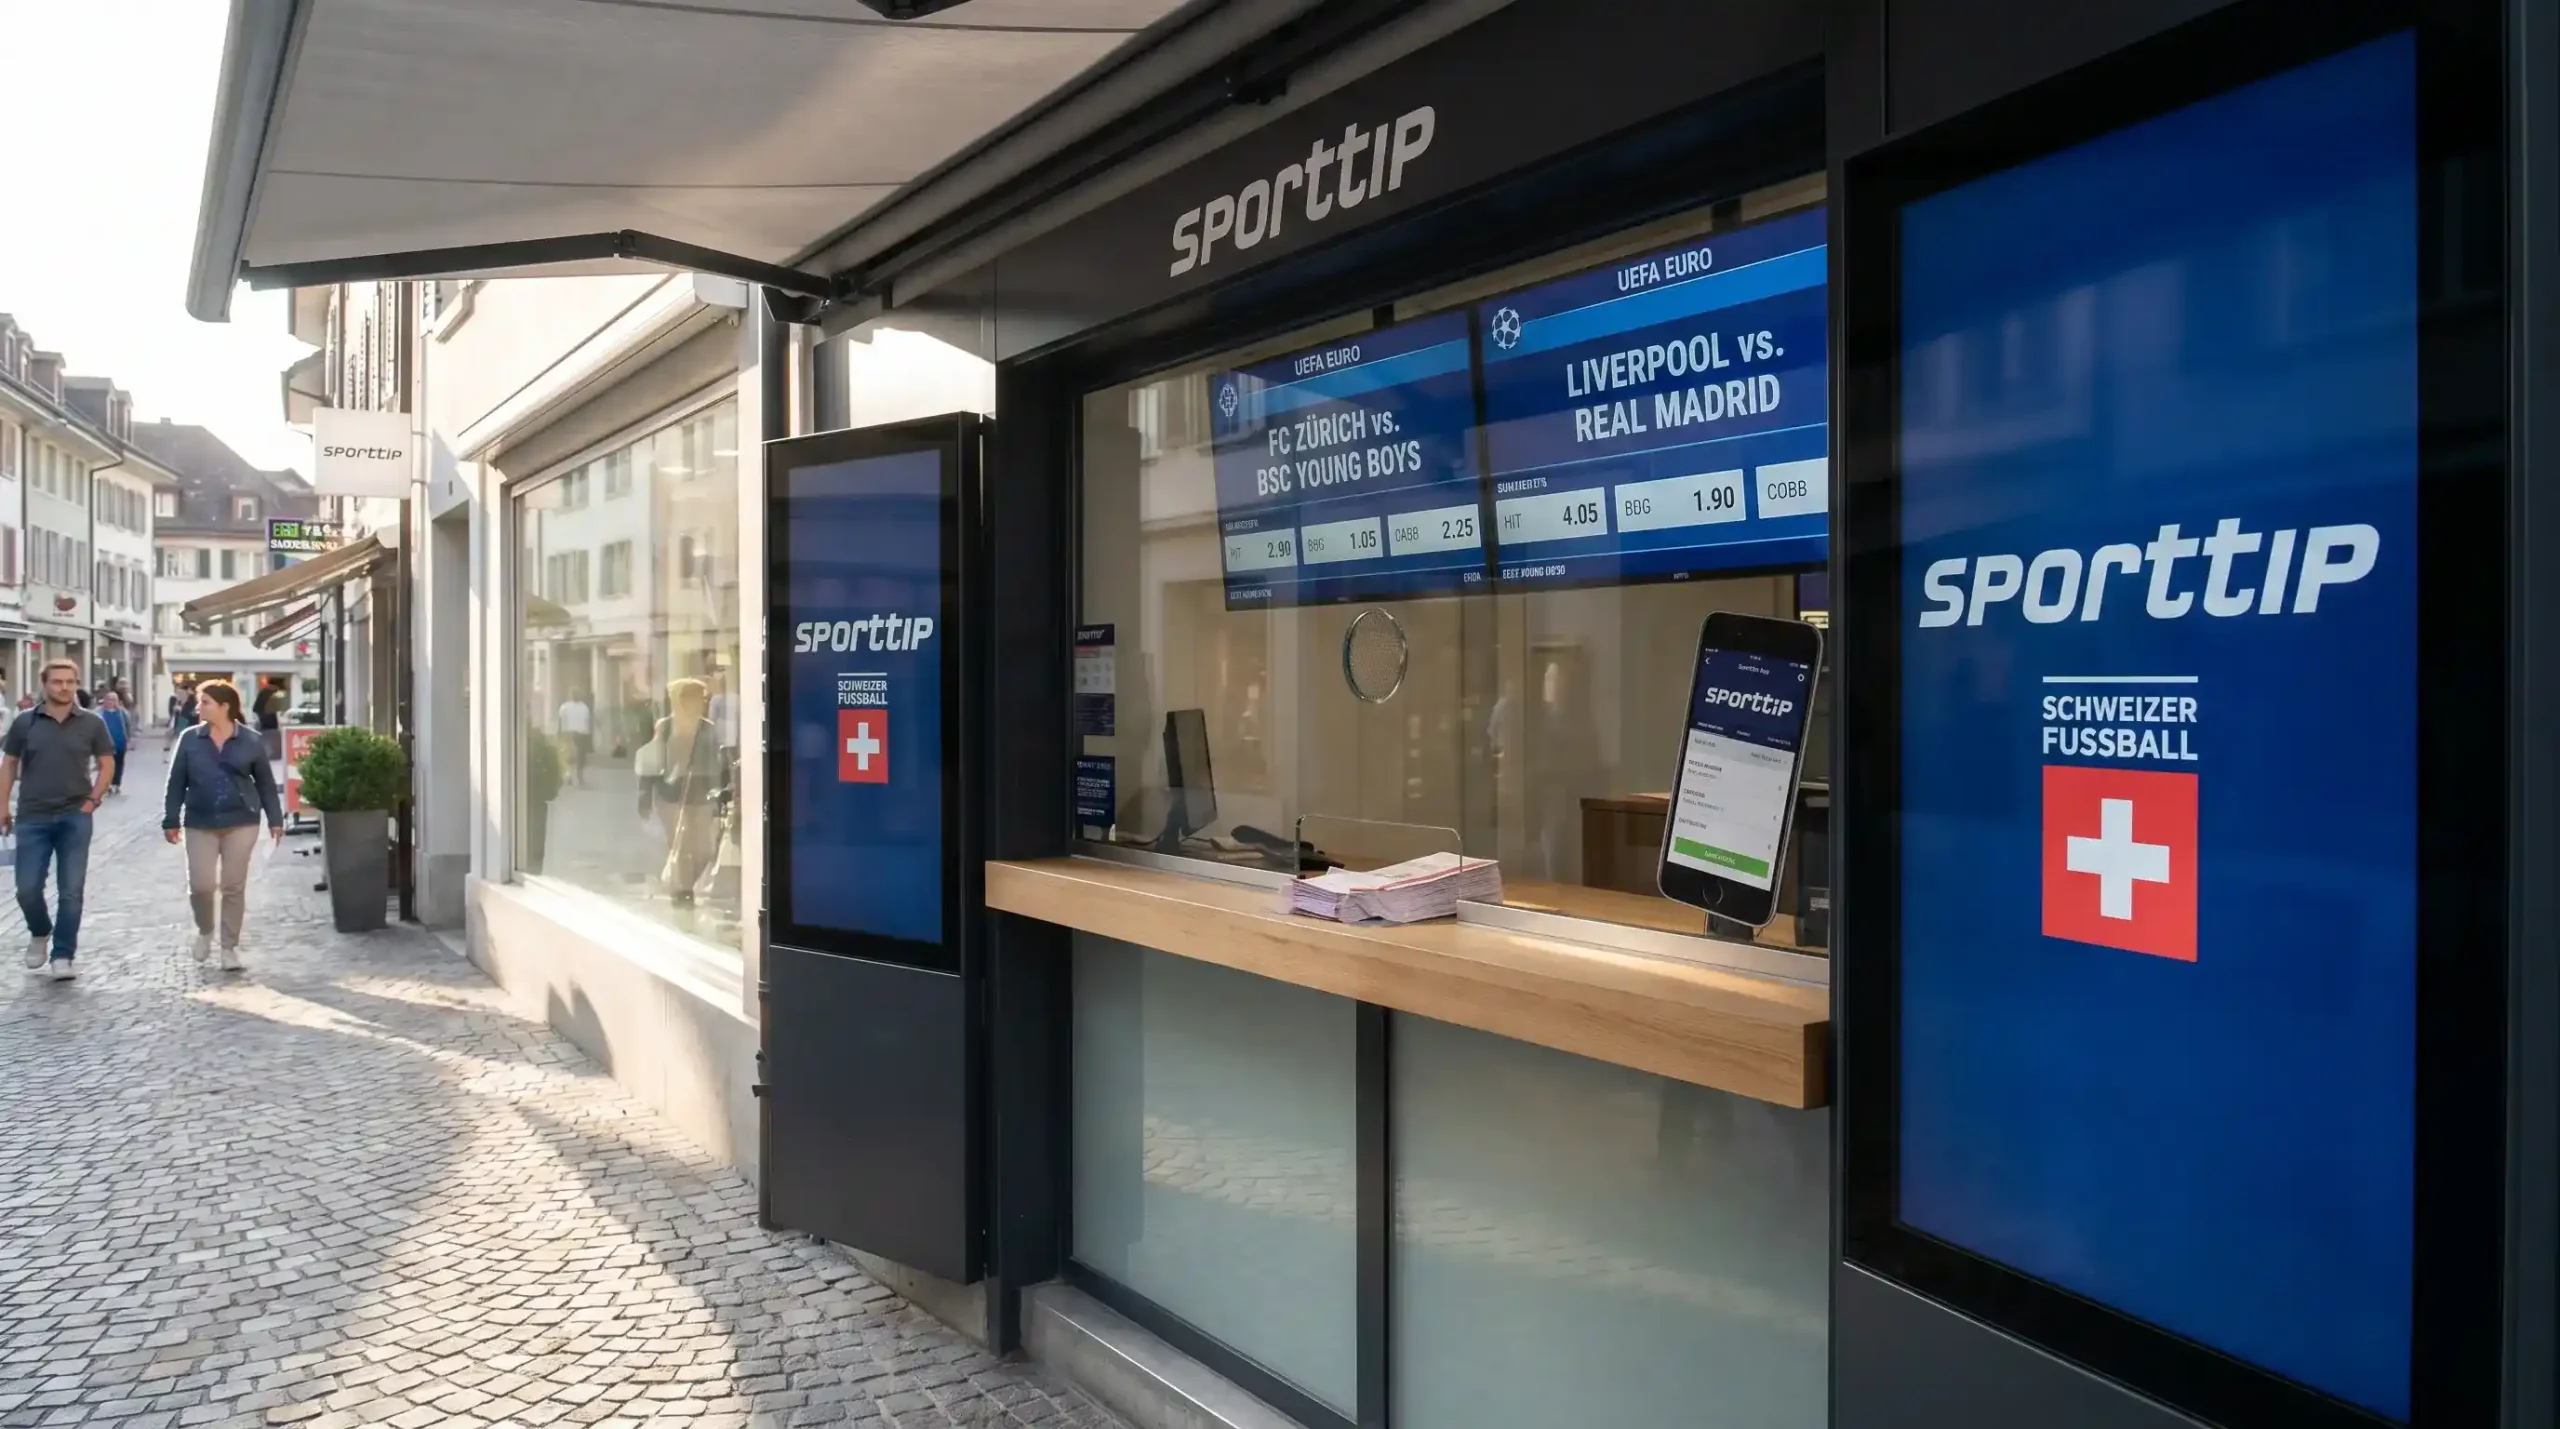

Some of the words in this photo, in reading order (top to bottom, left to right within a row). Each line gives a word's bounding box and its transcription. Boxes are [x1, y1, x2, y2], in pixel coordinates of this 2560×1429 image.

[1617, 262, 1660, 291] UEFA
[1665, 247, 1713, 279] EURO
[1295, 354, 1325, 376] UEFA
[1326, 345, 1361, 368] EURO
[1567, 332, 1730, 398] LIVERPOOL
[1737, 330, 1784, 363] vs.
[1575, 399, 1647, 442] REAL
[1654, 374, 1780, 430] MADRID
[1269, 426, 1291, 457] FC
[1371, 411, 1400, 436] vs.
[1257, 464, 1291, 496] BSC
[1296, 451, 1362, 489] YOUNG
[1367, 440, 1421, 478] BOYS
[1693, 486, 1735, 512] 1.90
[1767, 480, 1808, 500] COBB
[1442, 518, 1473, 540] 2.25
[1504, 513, 1521, 529] HIT
[1563, 502, 1598, 525] 4.05
[1267, 540, 1291, 558] 2.90
[1350, 530, 1376, 549] 1.05
[838, 680, 888, 691] SCHWEIZER
[838, 692, 888, 705] FUSSBALL
[2042, 695, 2198, 723] SCHWEIZER
[2042, 726, 2198, 761] FUSSBALL
